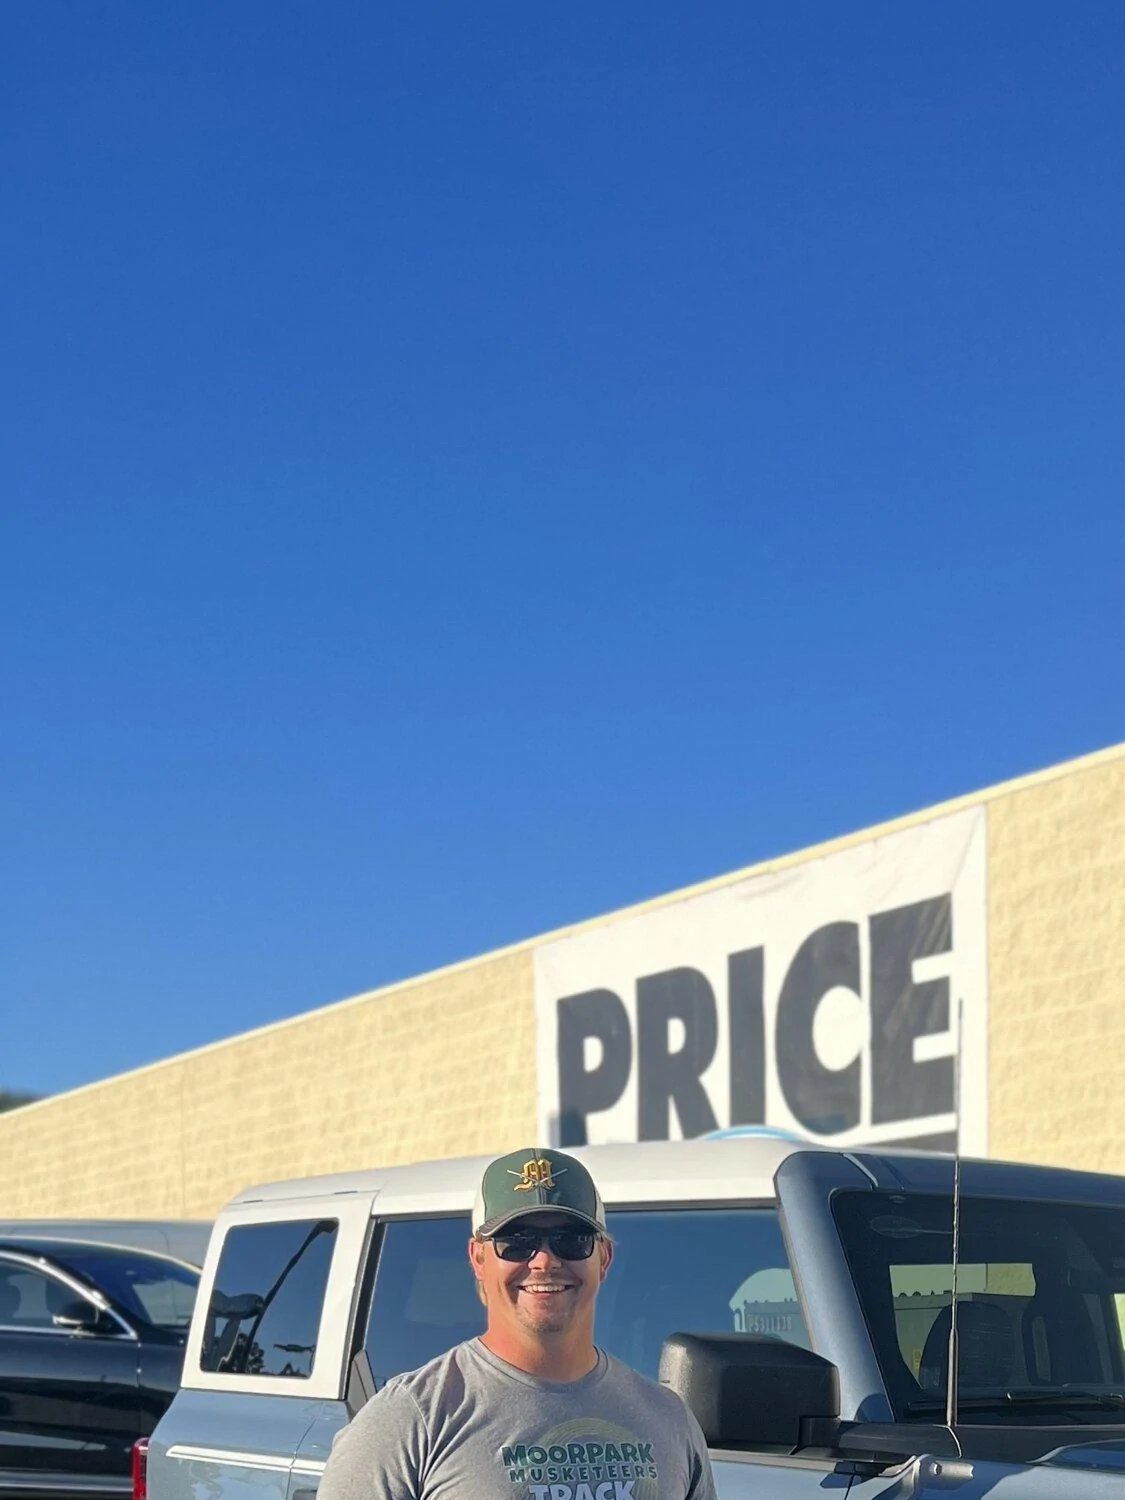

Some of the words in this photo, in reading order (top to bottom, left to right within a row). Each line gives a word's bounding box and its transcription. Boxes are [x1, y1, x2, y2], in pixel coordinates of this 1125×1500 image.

[556, 891, 957, 1148] PRICE
[501, 1442, 656, 1468] MOORPARK
[508, 1465, 659, 1484] MUSKETEERS
